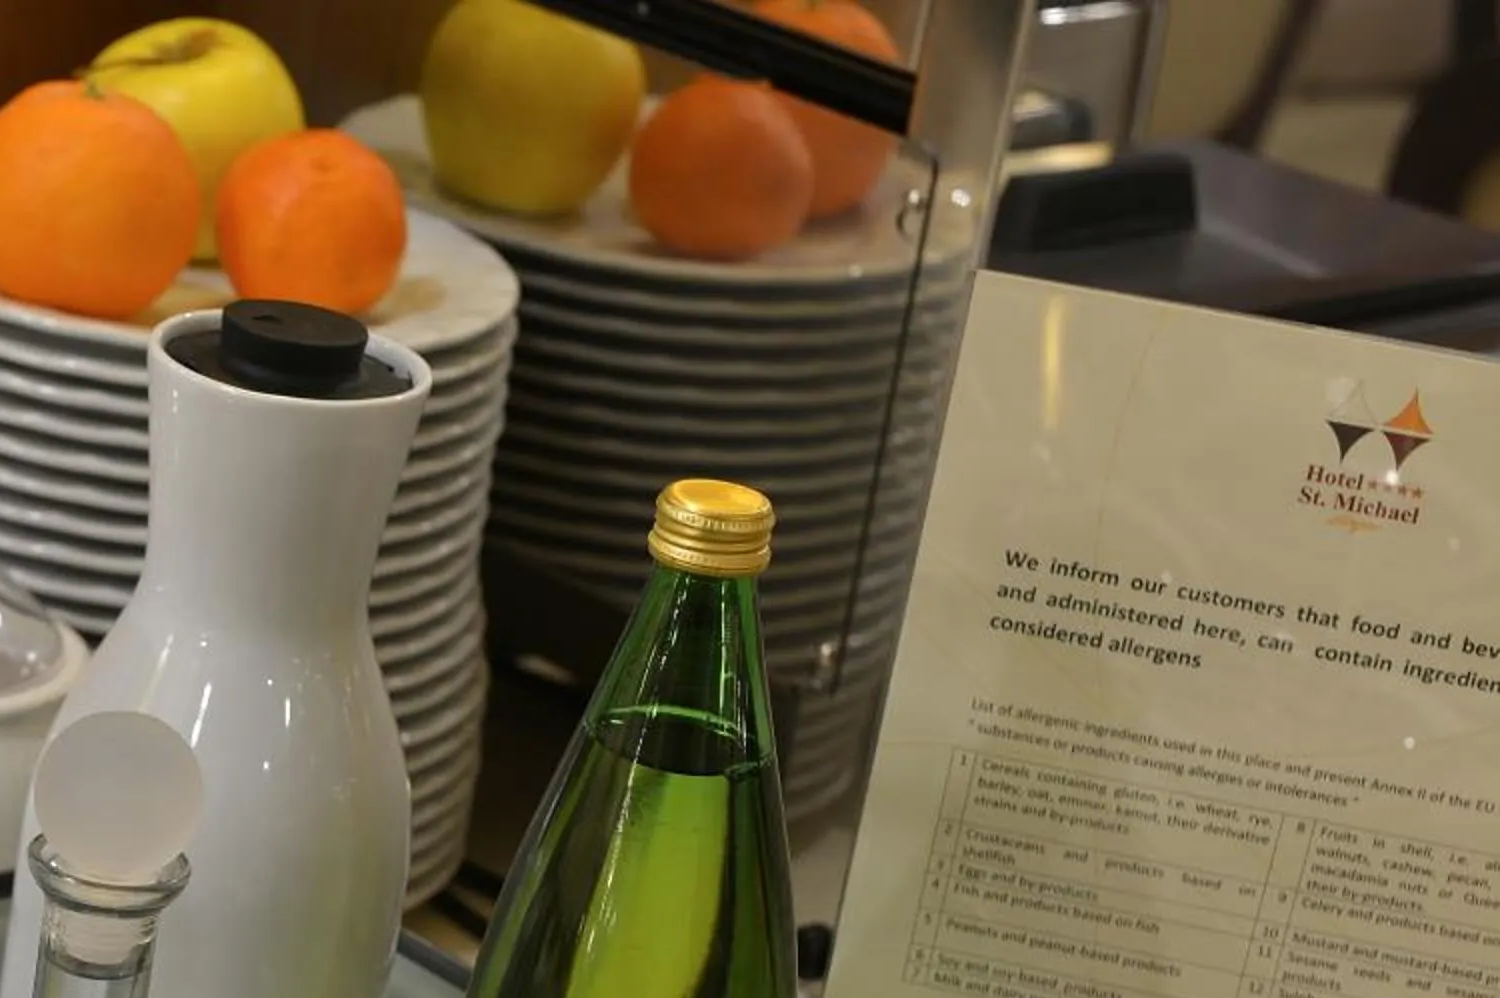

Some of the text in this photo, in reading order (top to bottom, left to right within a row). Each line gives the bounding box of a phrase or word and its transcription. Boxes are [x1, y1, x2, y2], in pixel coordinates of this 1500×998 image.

[1307, 464, 1364, 490] Hotel
[1298, 487, 1419, 525] St. Michael
[1002, 547, 1040, 571] We
[1048, 556, 1120, 587] inform
[1129, 575, 1168, 596] our
[1176, 584, 1286, 619] customers
[1294, 604, 1342, 629] that
[1349, 614, 1402, 641] food
[1409, 629, 1453, 650] and
[988, 614, 1203, 670] considered allergens
[995, 583, 1037, 604] and
[1044, 591, 1184, 632] administered
[1191, 617, 1245, 650] here,
[1255, 633, 1294, 654] can
[1312, 645, 1394, 673] contain
[970, 697, 995, 714] List
[995, 704, 1013, 717] of
[1015, 707, 1079, 730] allergenic
[1083, 719, 1159, 746] ingredients
[1161, 737, 1197, 754] used
[1198, 742, 1214, 757] in
[1215, 745, 1242, 763] this
[1243, 752, 1281, 770] place
[1284, 762, 1311, 776] and
[1313, 767, 1367, 787] present
[1369, 776, 1414, 797] Annex
[1428, 789, 1446, 803] of
[1446, 791, 1472, 808] the
[1474, 797, 1497, 813] EU
[1052, 739, 1068, 750] or
[1069, 742, 1131, 763] products
[1132, 755, 1184, 776] causing
[1187, 765, 1244, 785] allergies
[1245, 777, 1261, 789] or
[1264, 779, 1348, 806] intolerances
[980, 758, 1030, 778] Cereals
[1036, 771, 1108, 797] containing
[1020, 805, 1047, 818] and
[964, 828, 1045, 855] Crustaceans
[1062, 850, 1089, 863] and
[1165, 814, 1271, 845] their derivative
[990, 872, 1016, 885] and
[1305, 879, 1339, 896] their
[982, 890, 1009, 903] and
[1009, 896, 1069, 915] products
[1071, 905, 1113, 924] based
[1113, 917, 1133, 928] on
[1300, 896, 1480, 943] Celery and products based
[1000, 931, 1027, 945] and
[1121, 956, 1182, 977] products
[1291, 931, 1350, 953] Mustard
[1352, 946, 1379, 959] and
[964, 961, 989, 974] and
[1280, 970, 1342, 991] products
[1404, 977, 1432, 991] and
[965, 981, 990, 993] and
